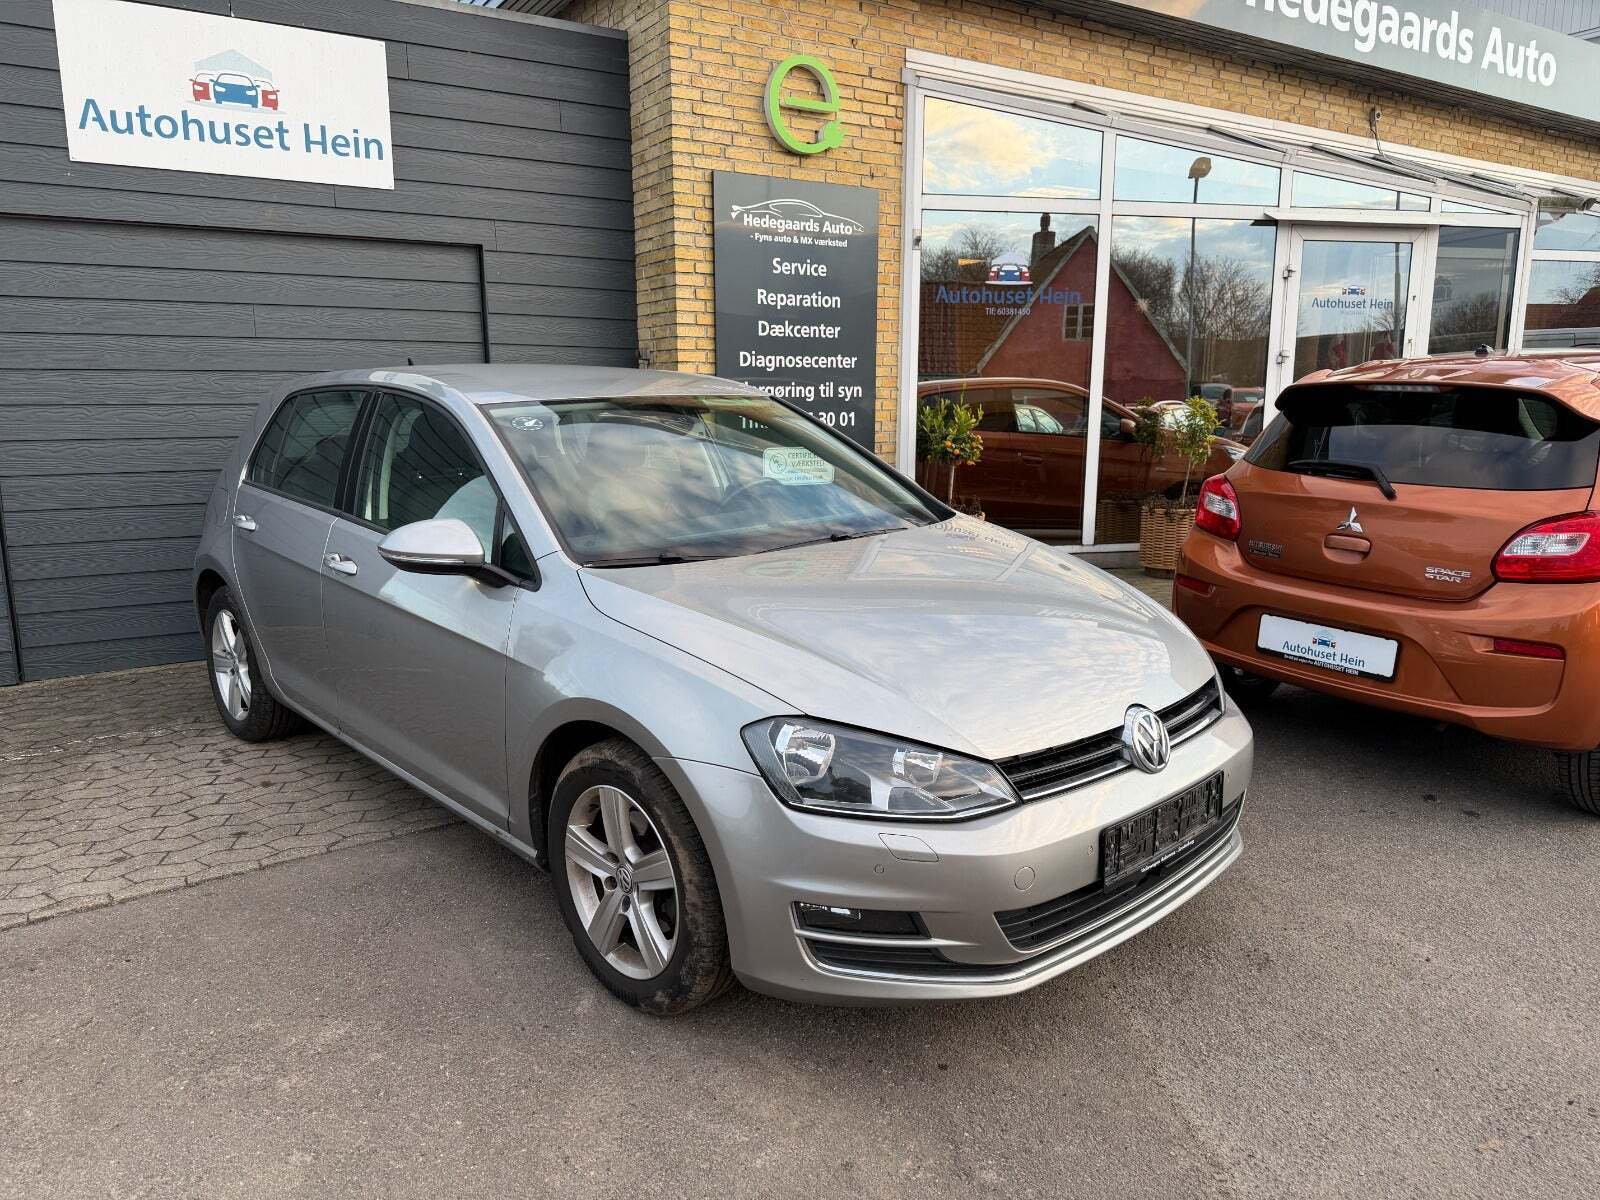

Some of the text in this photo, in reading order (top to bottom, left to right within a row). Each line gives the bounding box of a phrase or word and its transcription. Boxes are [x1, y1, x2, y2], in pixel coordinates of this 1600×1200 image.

[1246, 0, 1557, 87] edegaards Auto
[78, 98, 385, 161] Autohuset Hein
[743, 213, 853, 235] Hedegaards Auto
[755, 232, 773, 243] Fyns
[774, 235, 792, 244] auto
[793, 236, 799, 244] &
[800, 237, 813, 246] MX
[814, 238, 848, 248] værksted
[772, 257, 828, 277] Service
[757, 288, 841, 310] Reparation
[935, 284, 1082, 305] Autohuset Hein
[1311, 297, 1393, 310] Autohuset Hein
[758, 320, 841, 338] Dækcenter
[739, 350, 858, 372] Diagnosecenter
[819, 382, 834, 398] til
[838, 385, 863, 402] syn
[840, 411, 855, 427] 01
[1424, 573, 1462, 584] STAR
[1425, 566, 1472, 578] SPACE
[1282, 641, 1337, 661] Autohuset
[1340, 652, 1366, 669] Hein
